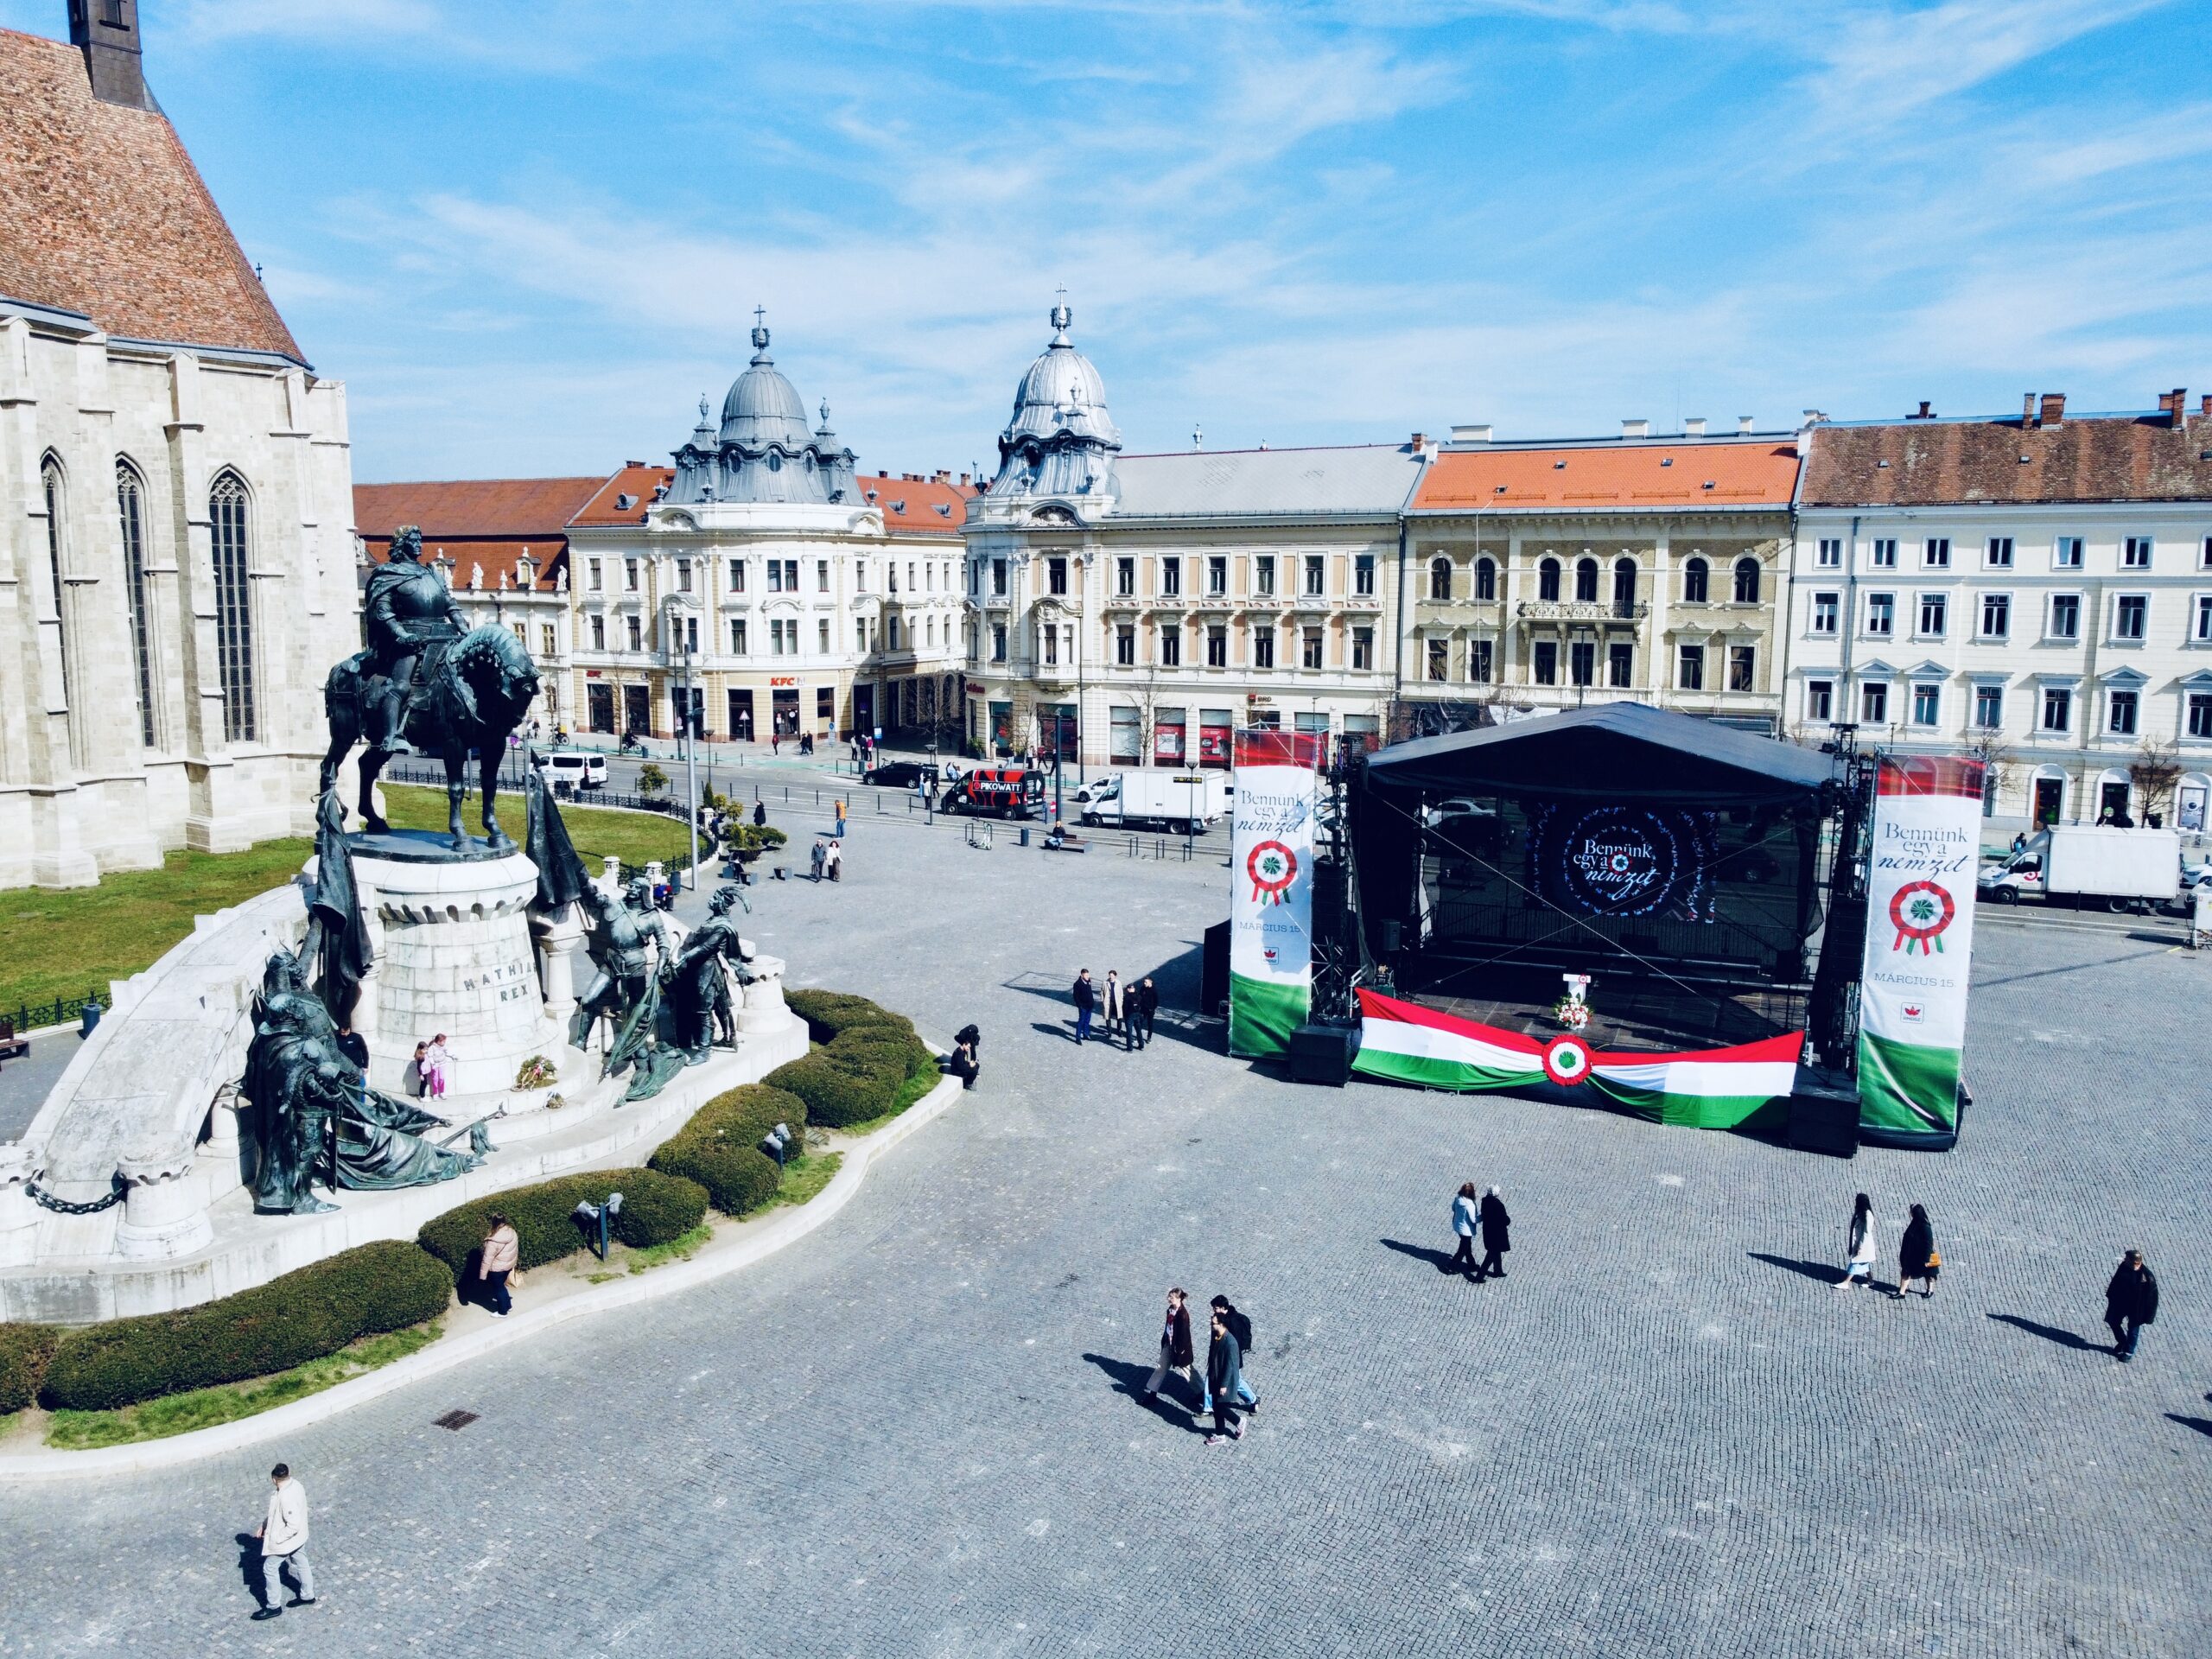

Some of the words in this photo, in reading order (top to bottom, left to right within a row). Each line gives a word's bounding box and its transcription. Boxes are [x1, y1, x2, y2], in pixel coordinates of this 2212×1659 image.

[770, 677, 795, 686] KFC
[980, 782, 1021, 792] PIKOWATT
[1242, 790, 1304, 807] Bennünk
[1255, 806, 1276, 821] egy
[1237, 817, 1307, 842] nemzet
[1885, 823, 1967, 842] Bennünk
[1584, 839, 1652, 858] Bennünk
[1903, 841, 1934, 858] egy
[1936, 843, 1948, 857] a
[1573, 854, 1599, 869] egy
[1599, 856, 1609, 869] a
[1878, 855, 1974, 882] nemzet
[1585, 868, 1661, 900] nemzet
[1874, 972, 1937, 987] MÁRCIUS
[500, 984, 529, 1001] REX
